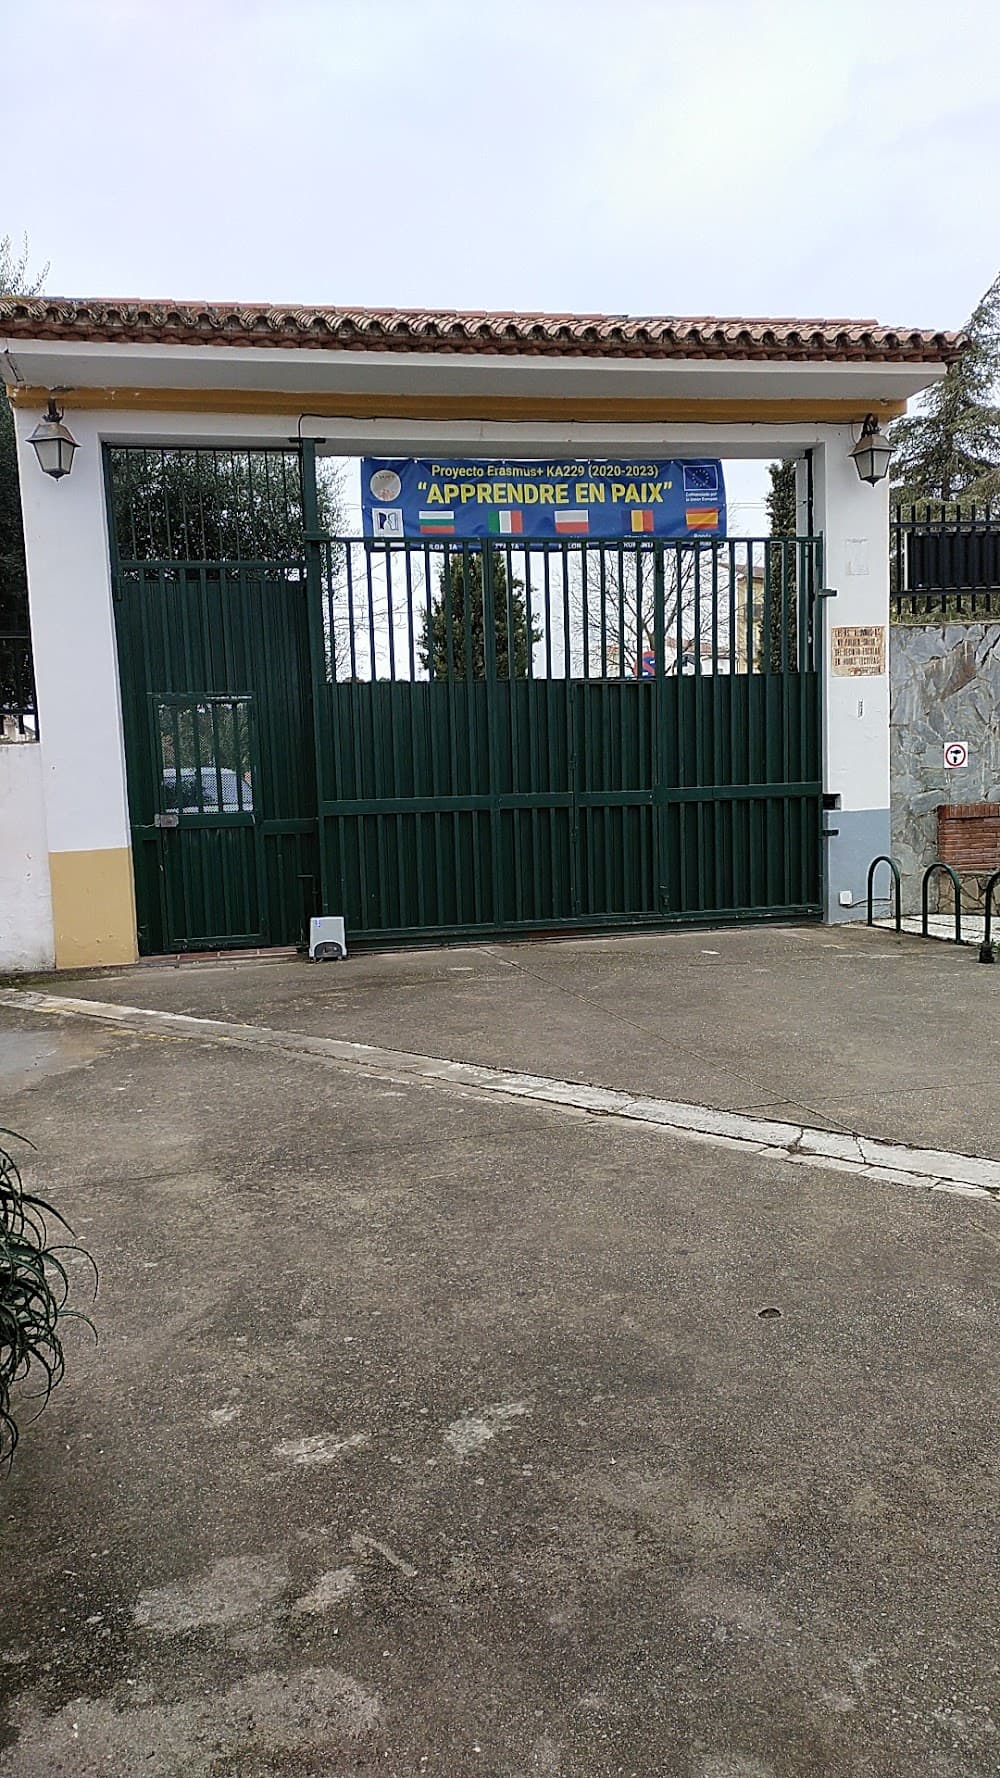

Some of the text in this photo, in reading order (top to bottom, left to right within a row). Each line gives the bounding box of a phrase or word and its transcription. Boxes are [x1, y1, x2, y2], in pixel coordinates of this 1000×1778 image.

[431, 464, 659, 479] Proyecto Erasmus+ KA229 (2020-2023)
[575, 482, 606, 504] EN
